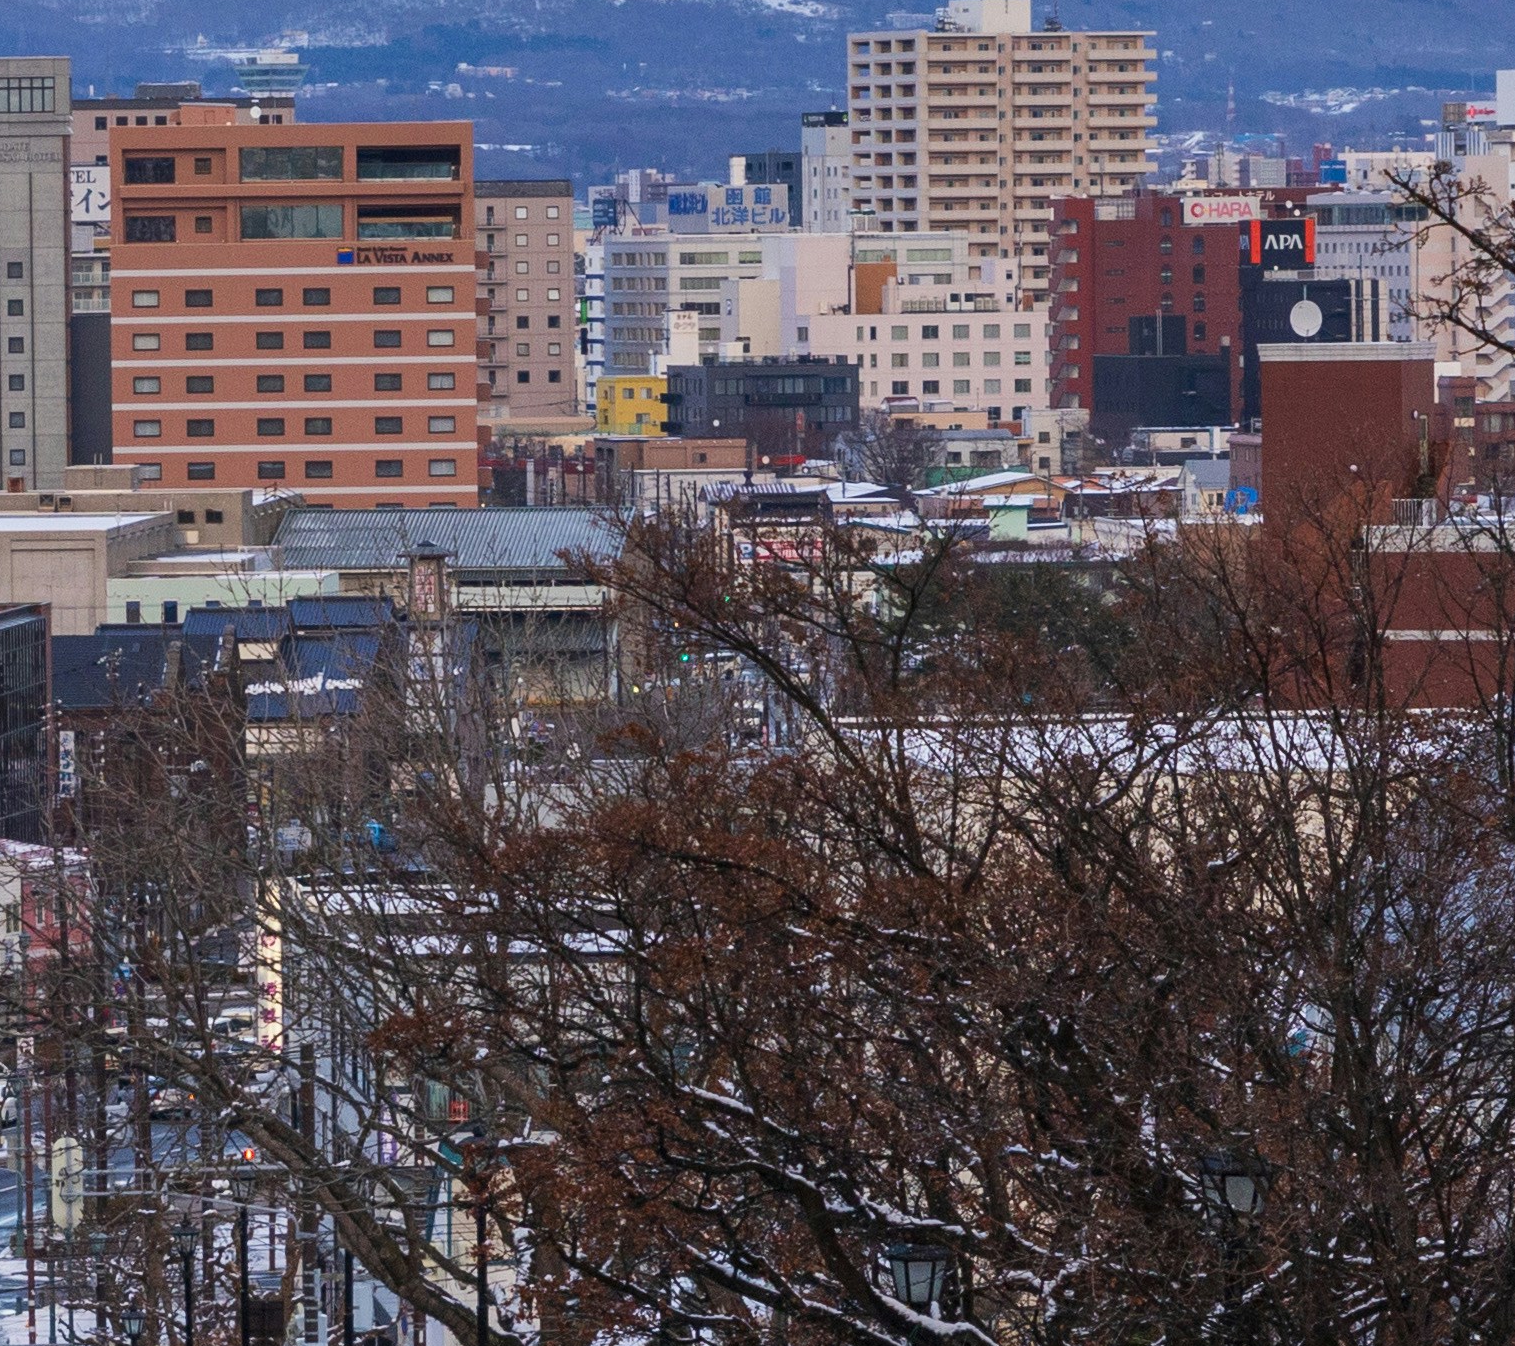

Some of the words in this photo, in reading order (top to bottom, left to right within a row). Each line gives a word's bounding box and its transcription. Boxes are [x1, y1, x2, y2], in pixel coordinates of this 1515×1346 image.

[726, 186, 772, 206] 函館
[711, 206, 786, 226] 北洋ビル
[1264, 234, 1303, 250] APA
[356, 252, 371, 264] LA
[374, 251, 408, 264] VISTA
[411, 251, 453, 264] ANNEX
